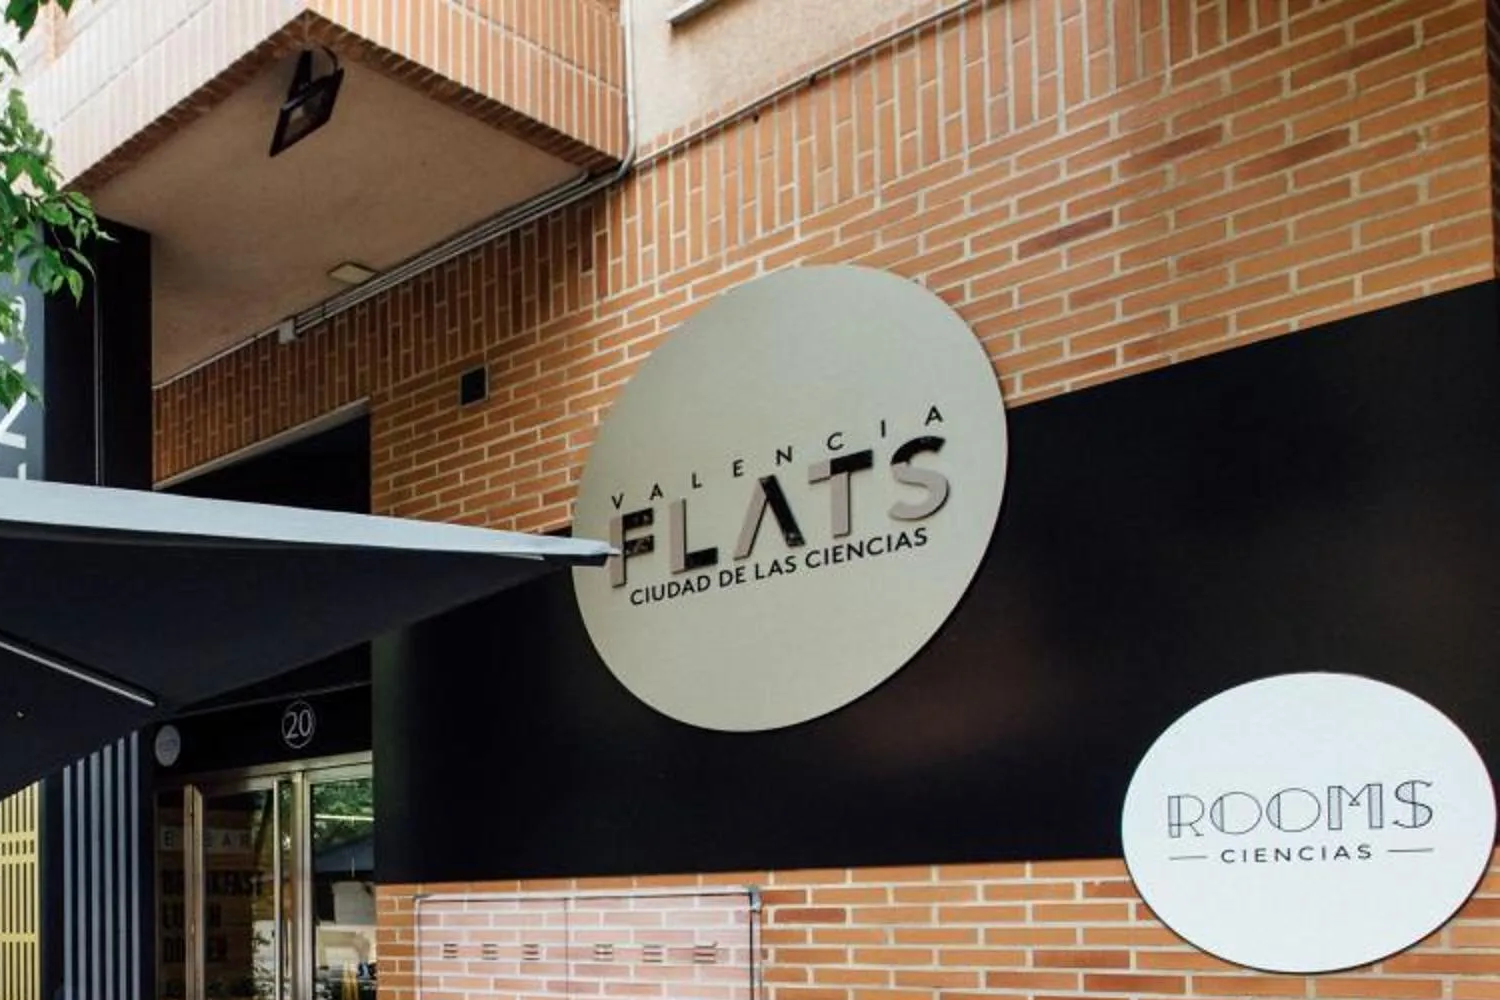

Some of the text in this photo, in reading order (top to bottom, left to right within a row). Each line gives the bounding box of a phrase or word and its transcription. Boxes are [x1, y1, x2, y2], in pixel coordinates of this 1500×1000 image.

[611, 404, 944, 509] VALENCIA
[608, 435, 952, 589] FLATS
[628, 526, 929, 606] CIUDAD DE LAS CIENCIAS
[283, 708, 312, 739] 20
[1167, 779, 1434, 839] ROOMS
[1220, 843, 1373, 864] CIENCIAS
